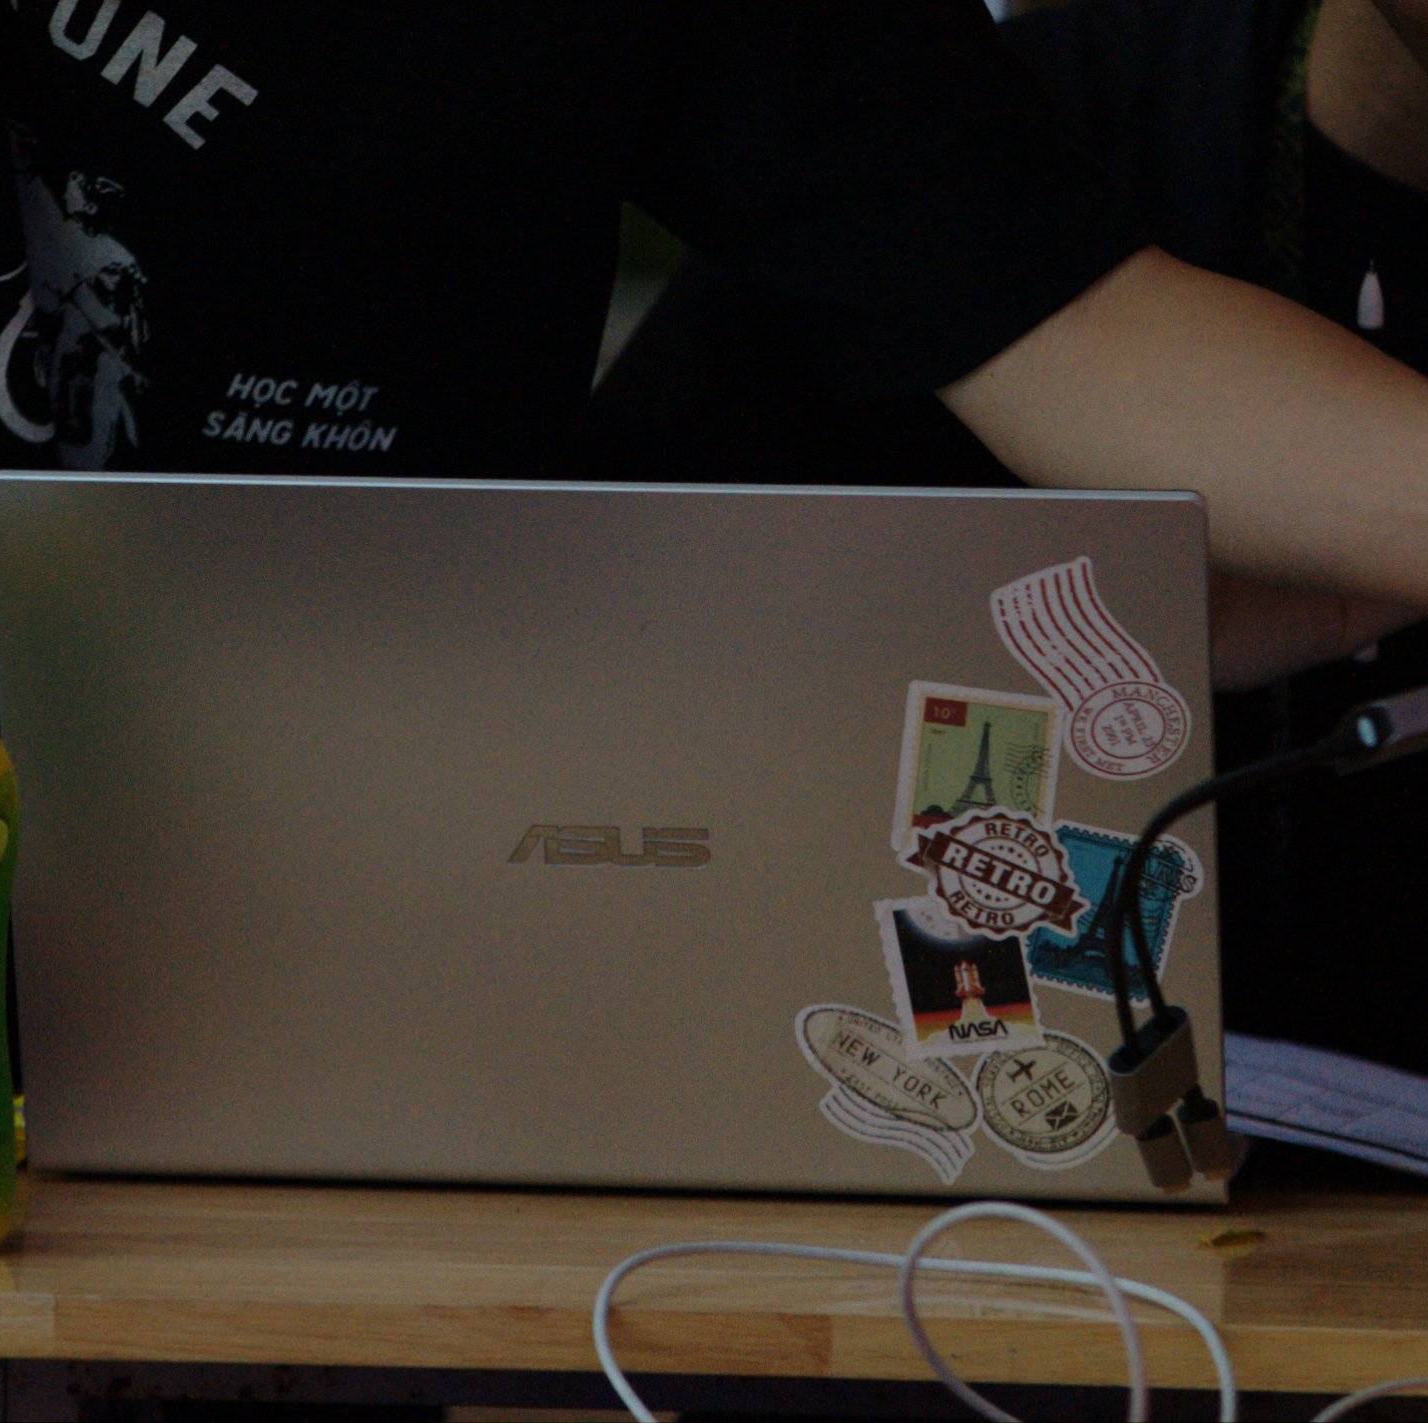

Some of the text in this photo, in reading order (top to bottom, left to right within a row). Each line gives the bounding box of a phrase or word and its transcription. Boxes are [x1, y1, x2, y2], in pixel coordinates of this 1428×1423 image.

[225, 372, 381, 418] HỌC MỘT
[201, 409, 399, 453] SÀNG KHÔN
[1112, 686, 1181, 764] MANCHESTER
[507, 824, 712, 867] ASUS
[984, 821, 1050, 858] RETRO
[941, 841, 1057, 906] RETRO
[949, 889, 1015, 926] RETRO
[948, 1020, 1009, 1040] NASA
[832, 1032, 881, 1067] NEW
[891, 1066, 948, 1110] YORK
[1010, 1068, 1074, 1117] ROME
